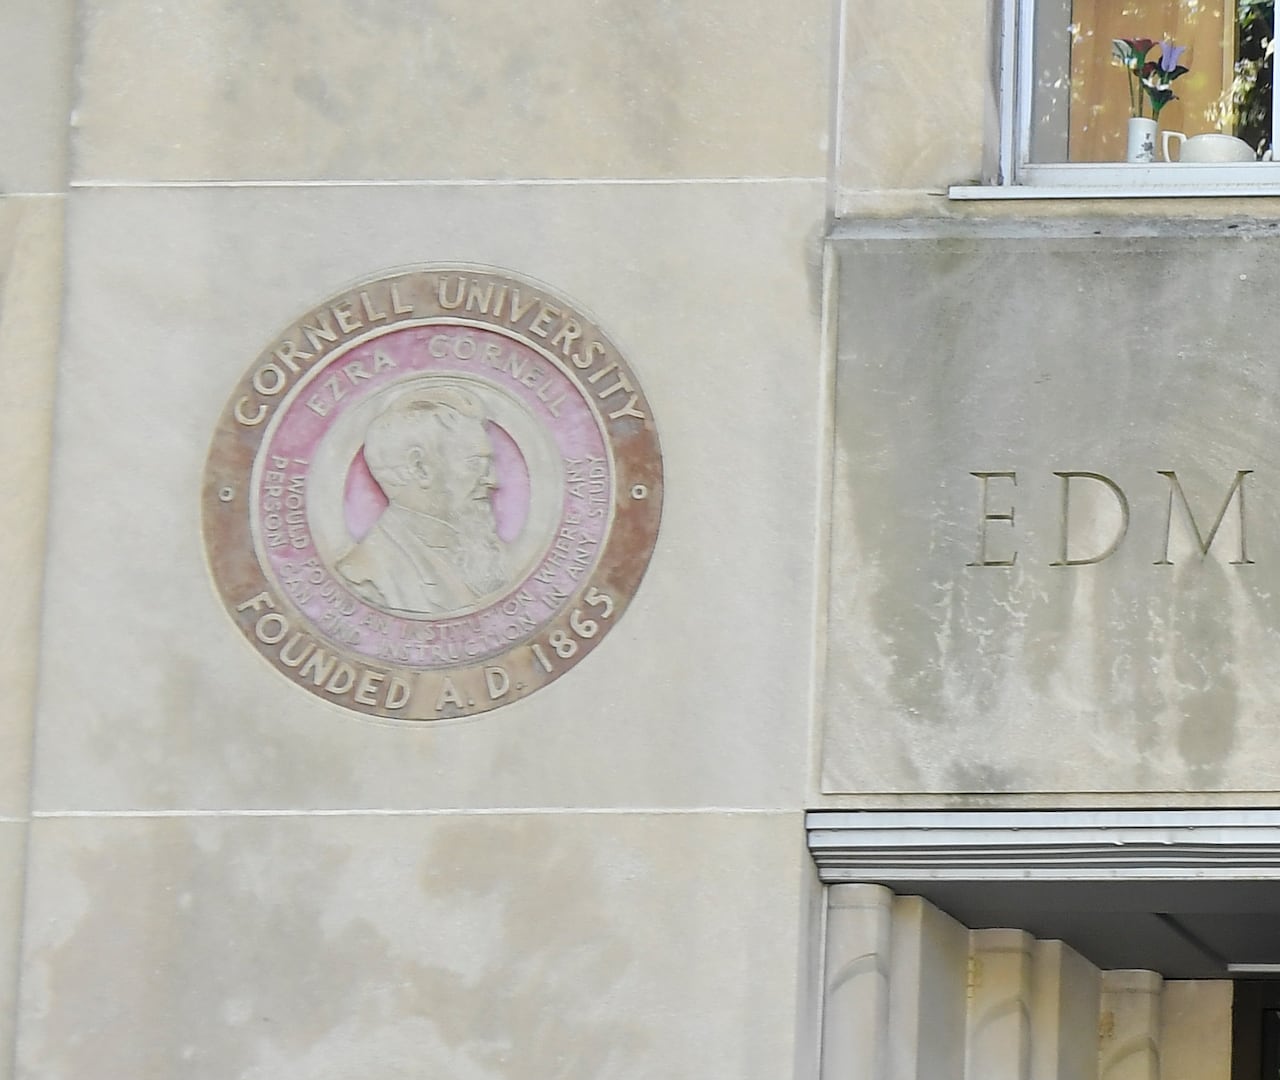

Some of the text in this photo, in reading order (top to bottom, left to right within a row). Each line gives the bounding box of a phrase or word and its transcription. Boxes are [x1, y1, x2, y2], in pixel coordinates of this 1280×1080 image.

[234, 277, 646, 426] CORNELL UNIVERSITY
[305, 334, 567, 419] EZRA CORNELL
[264, 455, 290, 548] PERSON
[542, 587, 568, 610] IN
[566, 534, 597, 582] ANY
[587, 456, 605, 518] STUDY
[285, 476, 307, 549] WOULD
[535, 512, 581, 585] WHERE
[565, 458, 586, 499] ANY
[236, 591, 411, 710] FOUNDED
[530, 586, 614, 674] 1865
